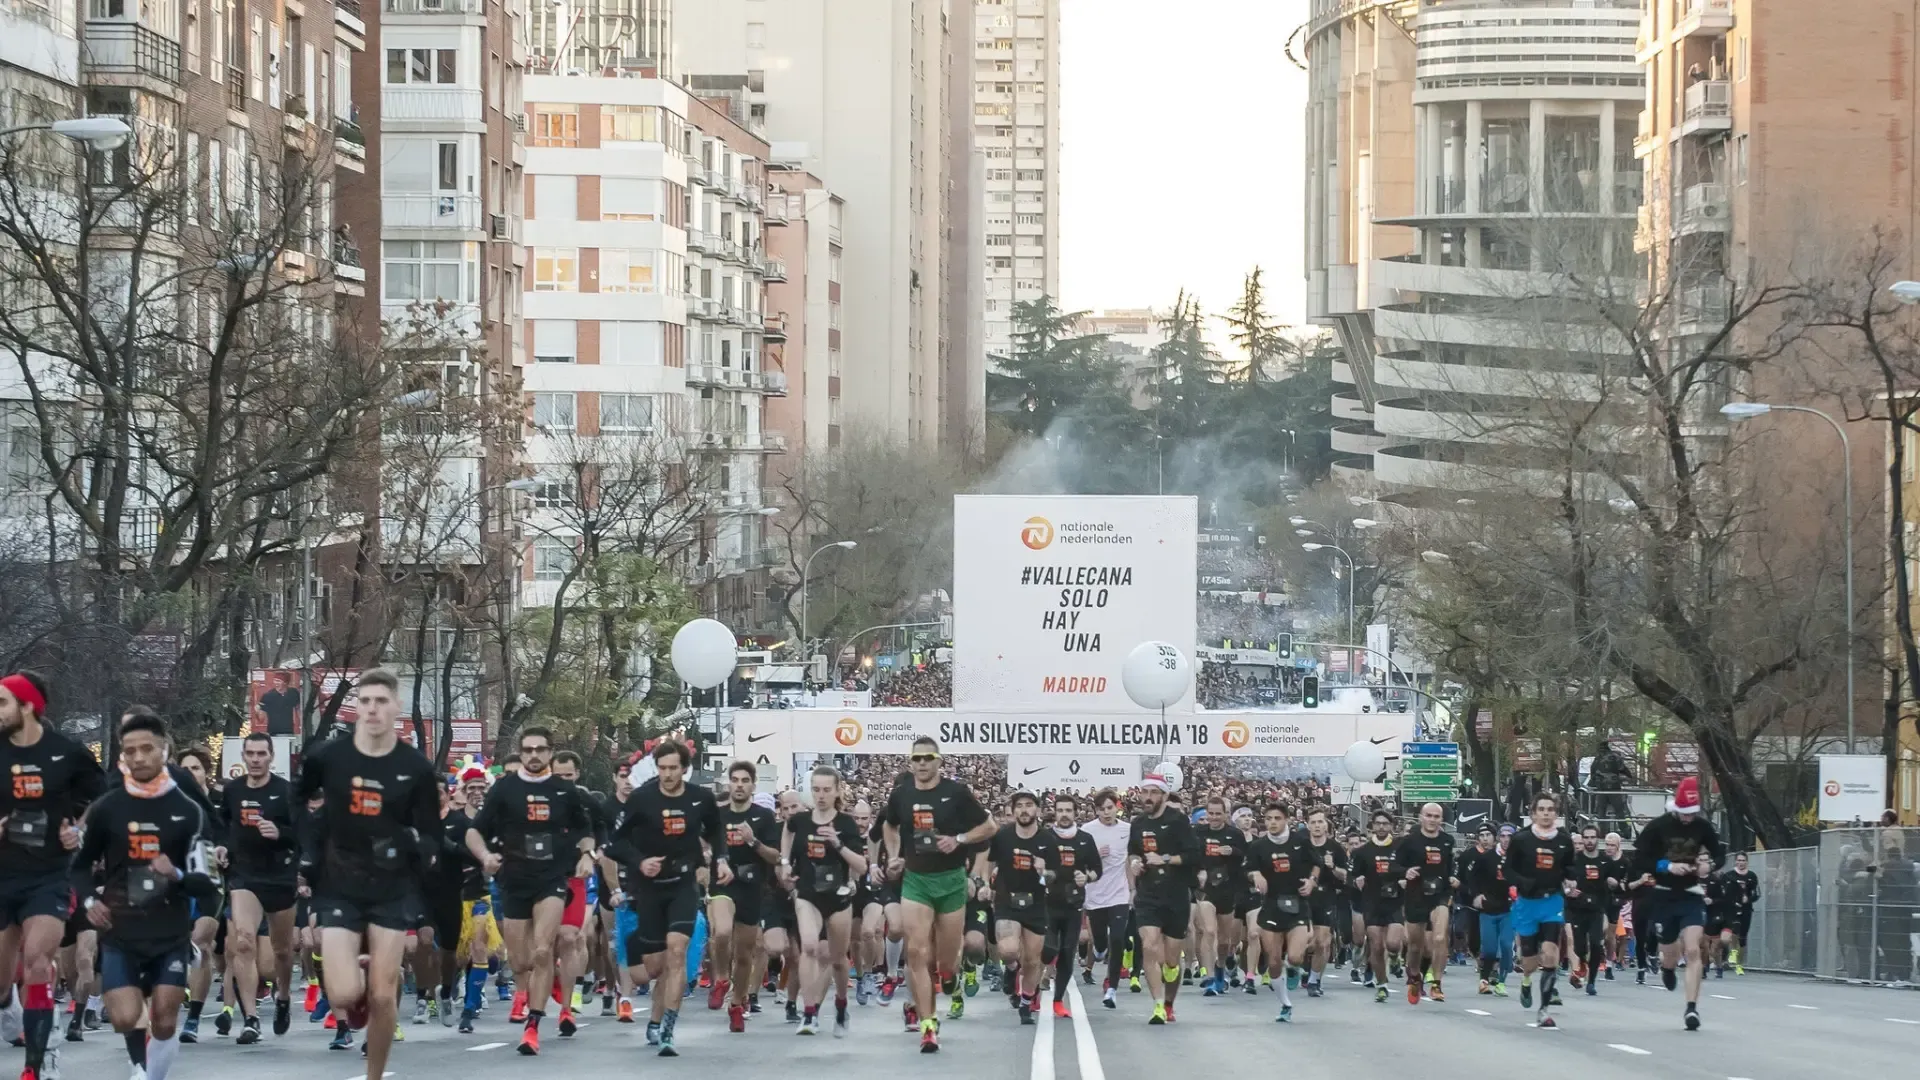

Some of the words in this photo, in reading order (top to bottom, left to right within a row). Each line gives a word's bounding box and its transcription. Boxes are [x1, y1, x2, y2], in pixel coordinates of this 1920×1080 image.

[1060, 522, 1114, 532] nationale
[1060, 534, 1133, 544] nederlanden
[1021, 566, 1132, 586] #VALLECANA
[1059, 588, 1109, 608] SOLO
[1042, 611, 1080, 630] HAY
[1063, 633, 1101, 652] UNA
[1043, 676, 1107, 693] MADRID
[867, 722, 912, 731] nationale
[1254, 725, 1300, 734] nationale
[940, 722, 975, 743] SAN
[979, 723, 1072, 744] SILVESTRE
[1077, 723, 1181, 745] VALLECANA
[1254, 734, 1316, 744] nederlanden
[1100, 767, 1125, 775] MARCA
